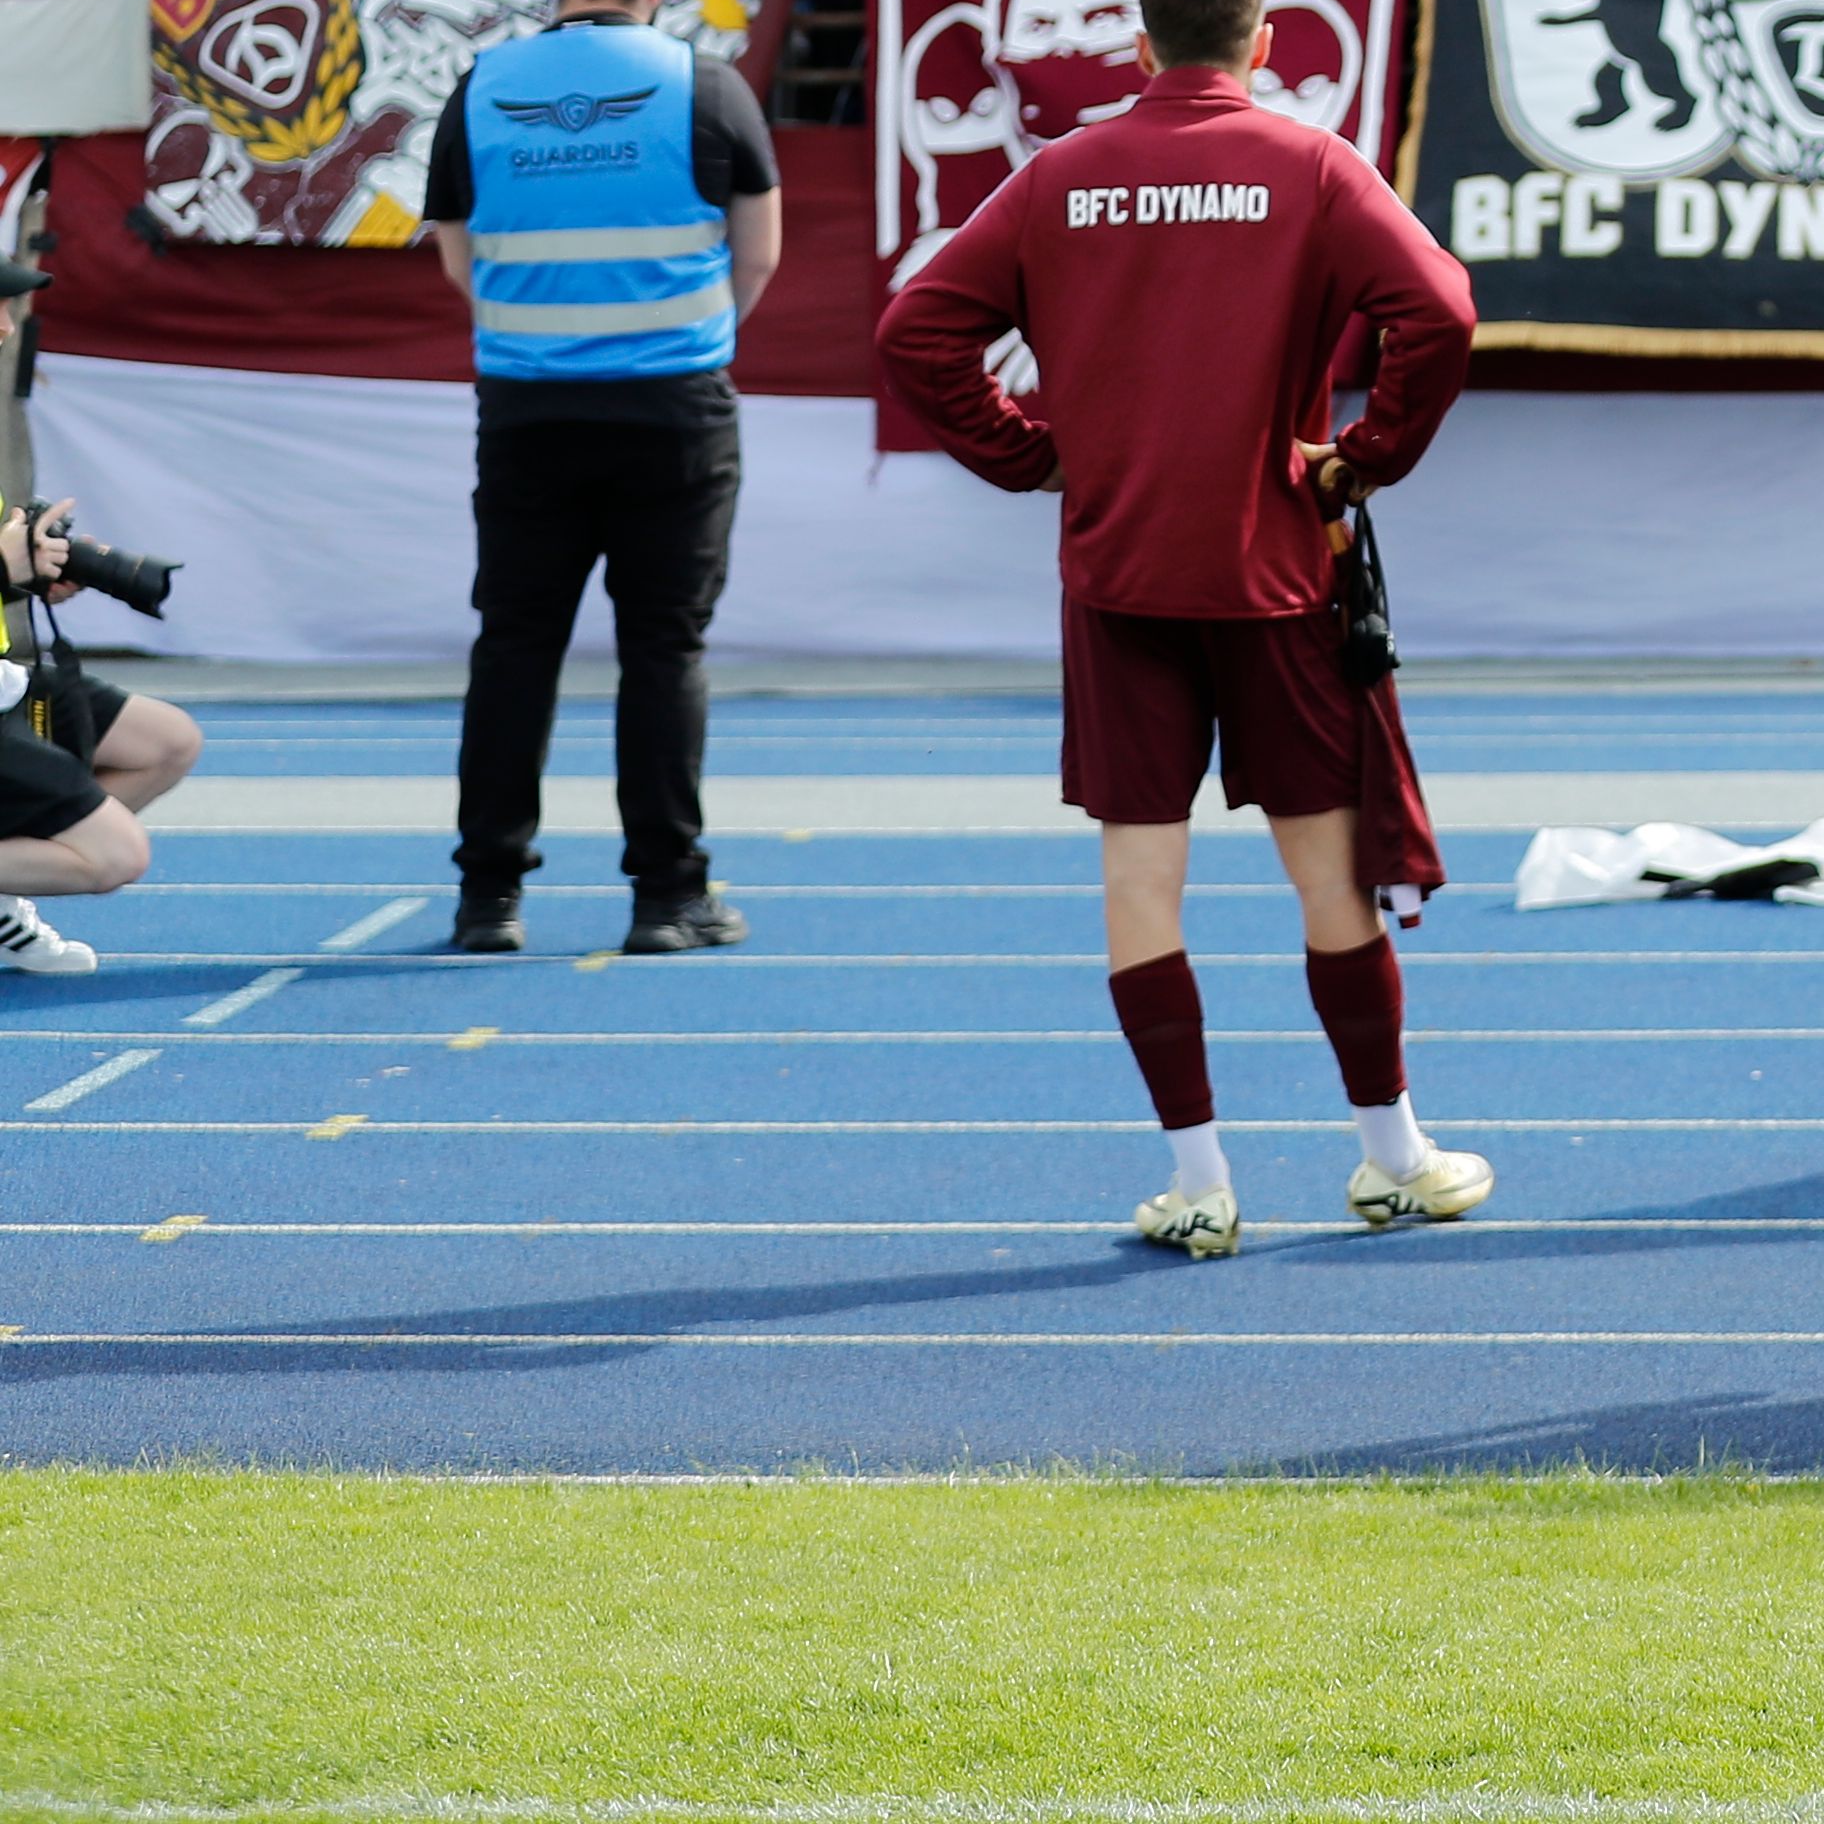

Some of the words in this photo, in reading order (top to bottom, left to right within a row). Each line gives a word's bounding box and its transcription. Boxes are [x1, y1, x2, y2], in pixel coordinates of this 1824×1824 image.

[511, 140, 639, 167] GUARDIUS
[1066, 187, 1129, 228] BFC
[1136, 184, 1270, 224] DYNAMO
[1452, 174, 1624, 262] BFC
